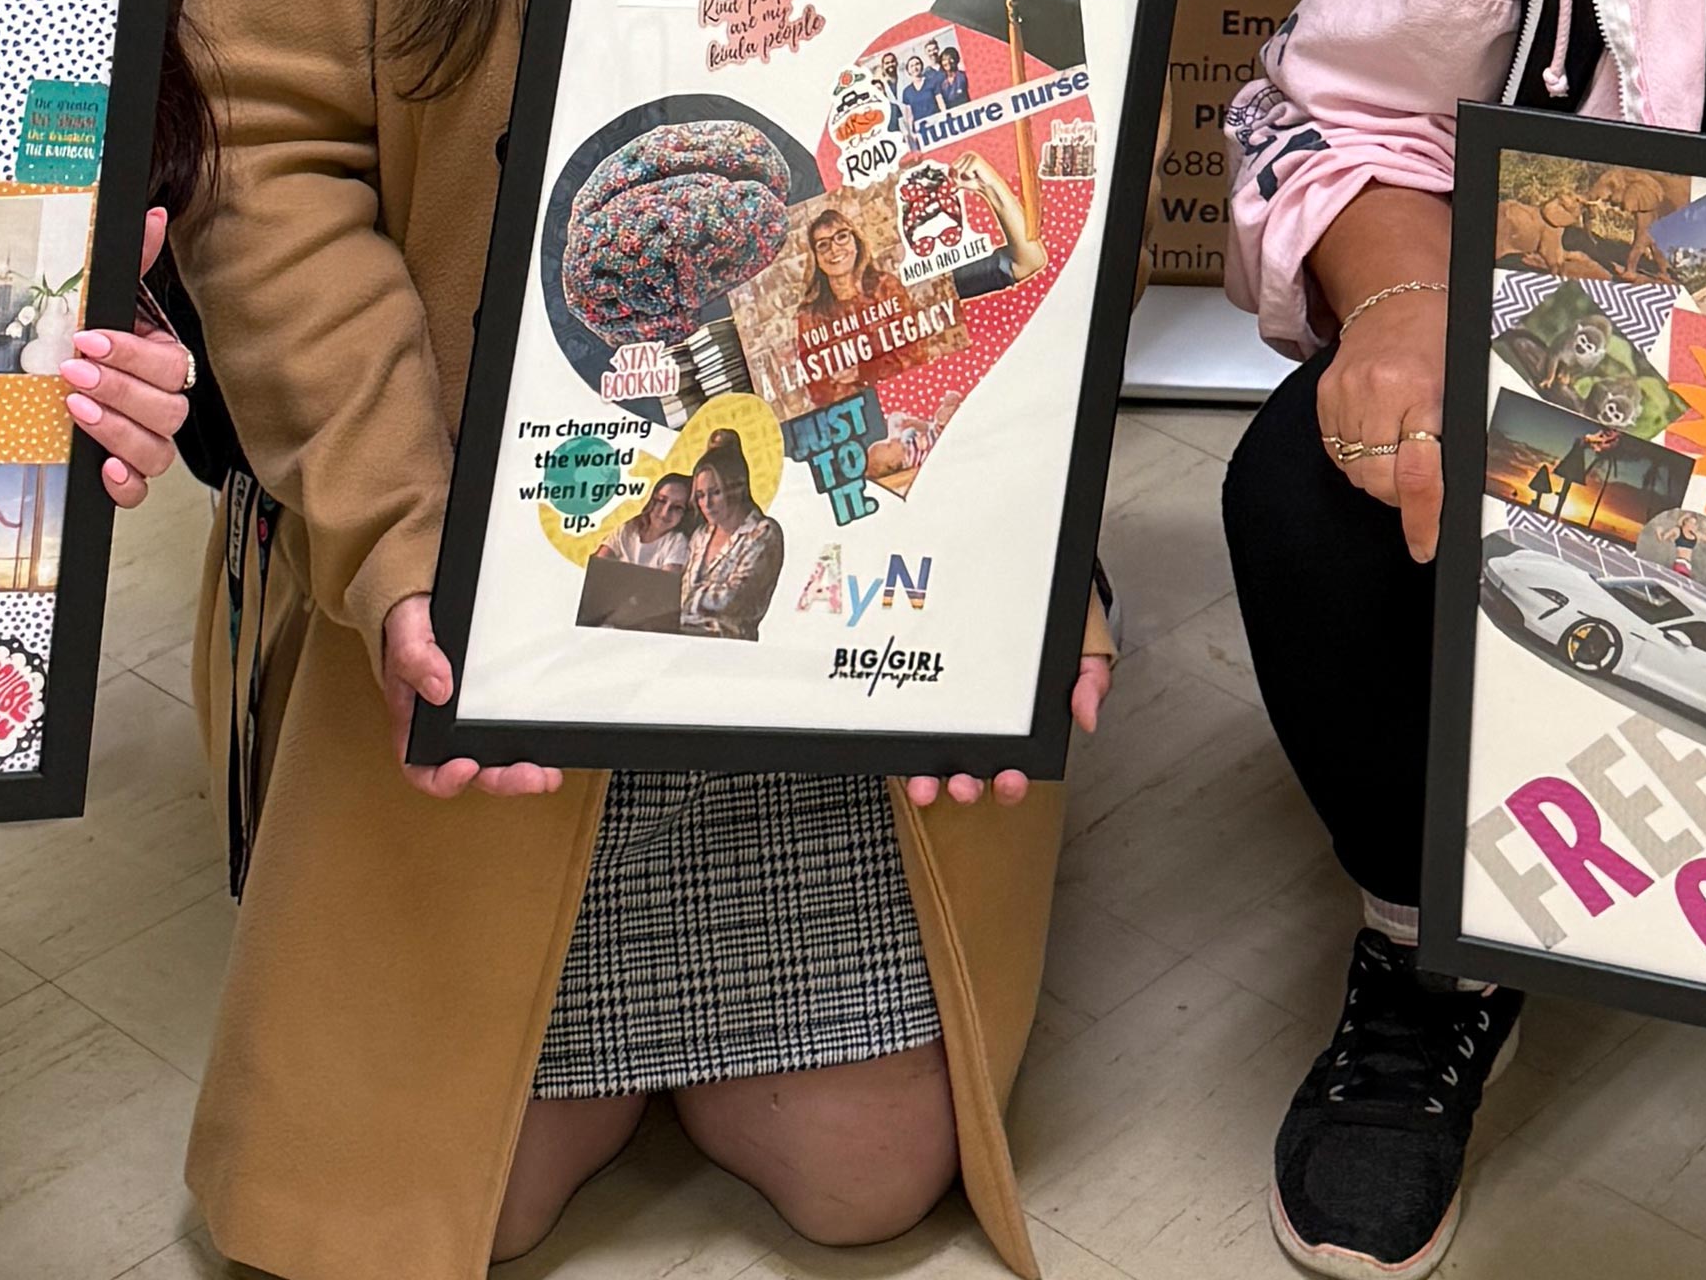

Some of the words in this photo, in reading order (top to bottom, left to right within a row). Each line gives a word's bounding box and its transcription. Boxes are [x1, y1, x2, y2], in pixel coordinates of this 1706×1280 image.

[710, 36, 758, 68] kinda
[764, 8, 824, 59] people
[730, 15, 758, 35] are
[762, 7, 791, 28] my
[918, 101, 1004, 146] future
[1011, 71, 1090, 114] nurse
[846, 140, 897, 182] ROAD
[1163, 150, 1224, 177] 688
[903, 262, 933, 282] MOM
[936, 251, 960, 270] AND
[964, 239, 989, 259] LIFE
[802, 326, 828, 349] YOU
[833, 315, 860, 337] CAN
[862, 297, 902, 325] LEAVE
[619, 343, 662, 371] STAY
[762, 373, 776, 402] A
[781, 334, 873, 392] LASTING
[879, 300, 957, 353] LEGACY
[603, 368, 677, 399] BOOKISH
[519, 422, 550, 438] I'm
[556, 417, 652, 439] changing
[535, 451, 569, 469] the
[574, 448, 634, 466] world
[813, 440, 867, 489] TO
[519, 482, 575, 500] when
[580, 482, 588, 498] I
[592, 482, 646, 502] grow
[832, 478, 876, 524] IT.
[564, 515, 596, 532] up.
[834, 635, 945, 697] BIG/GIRL
